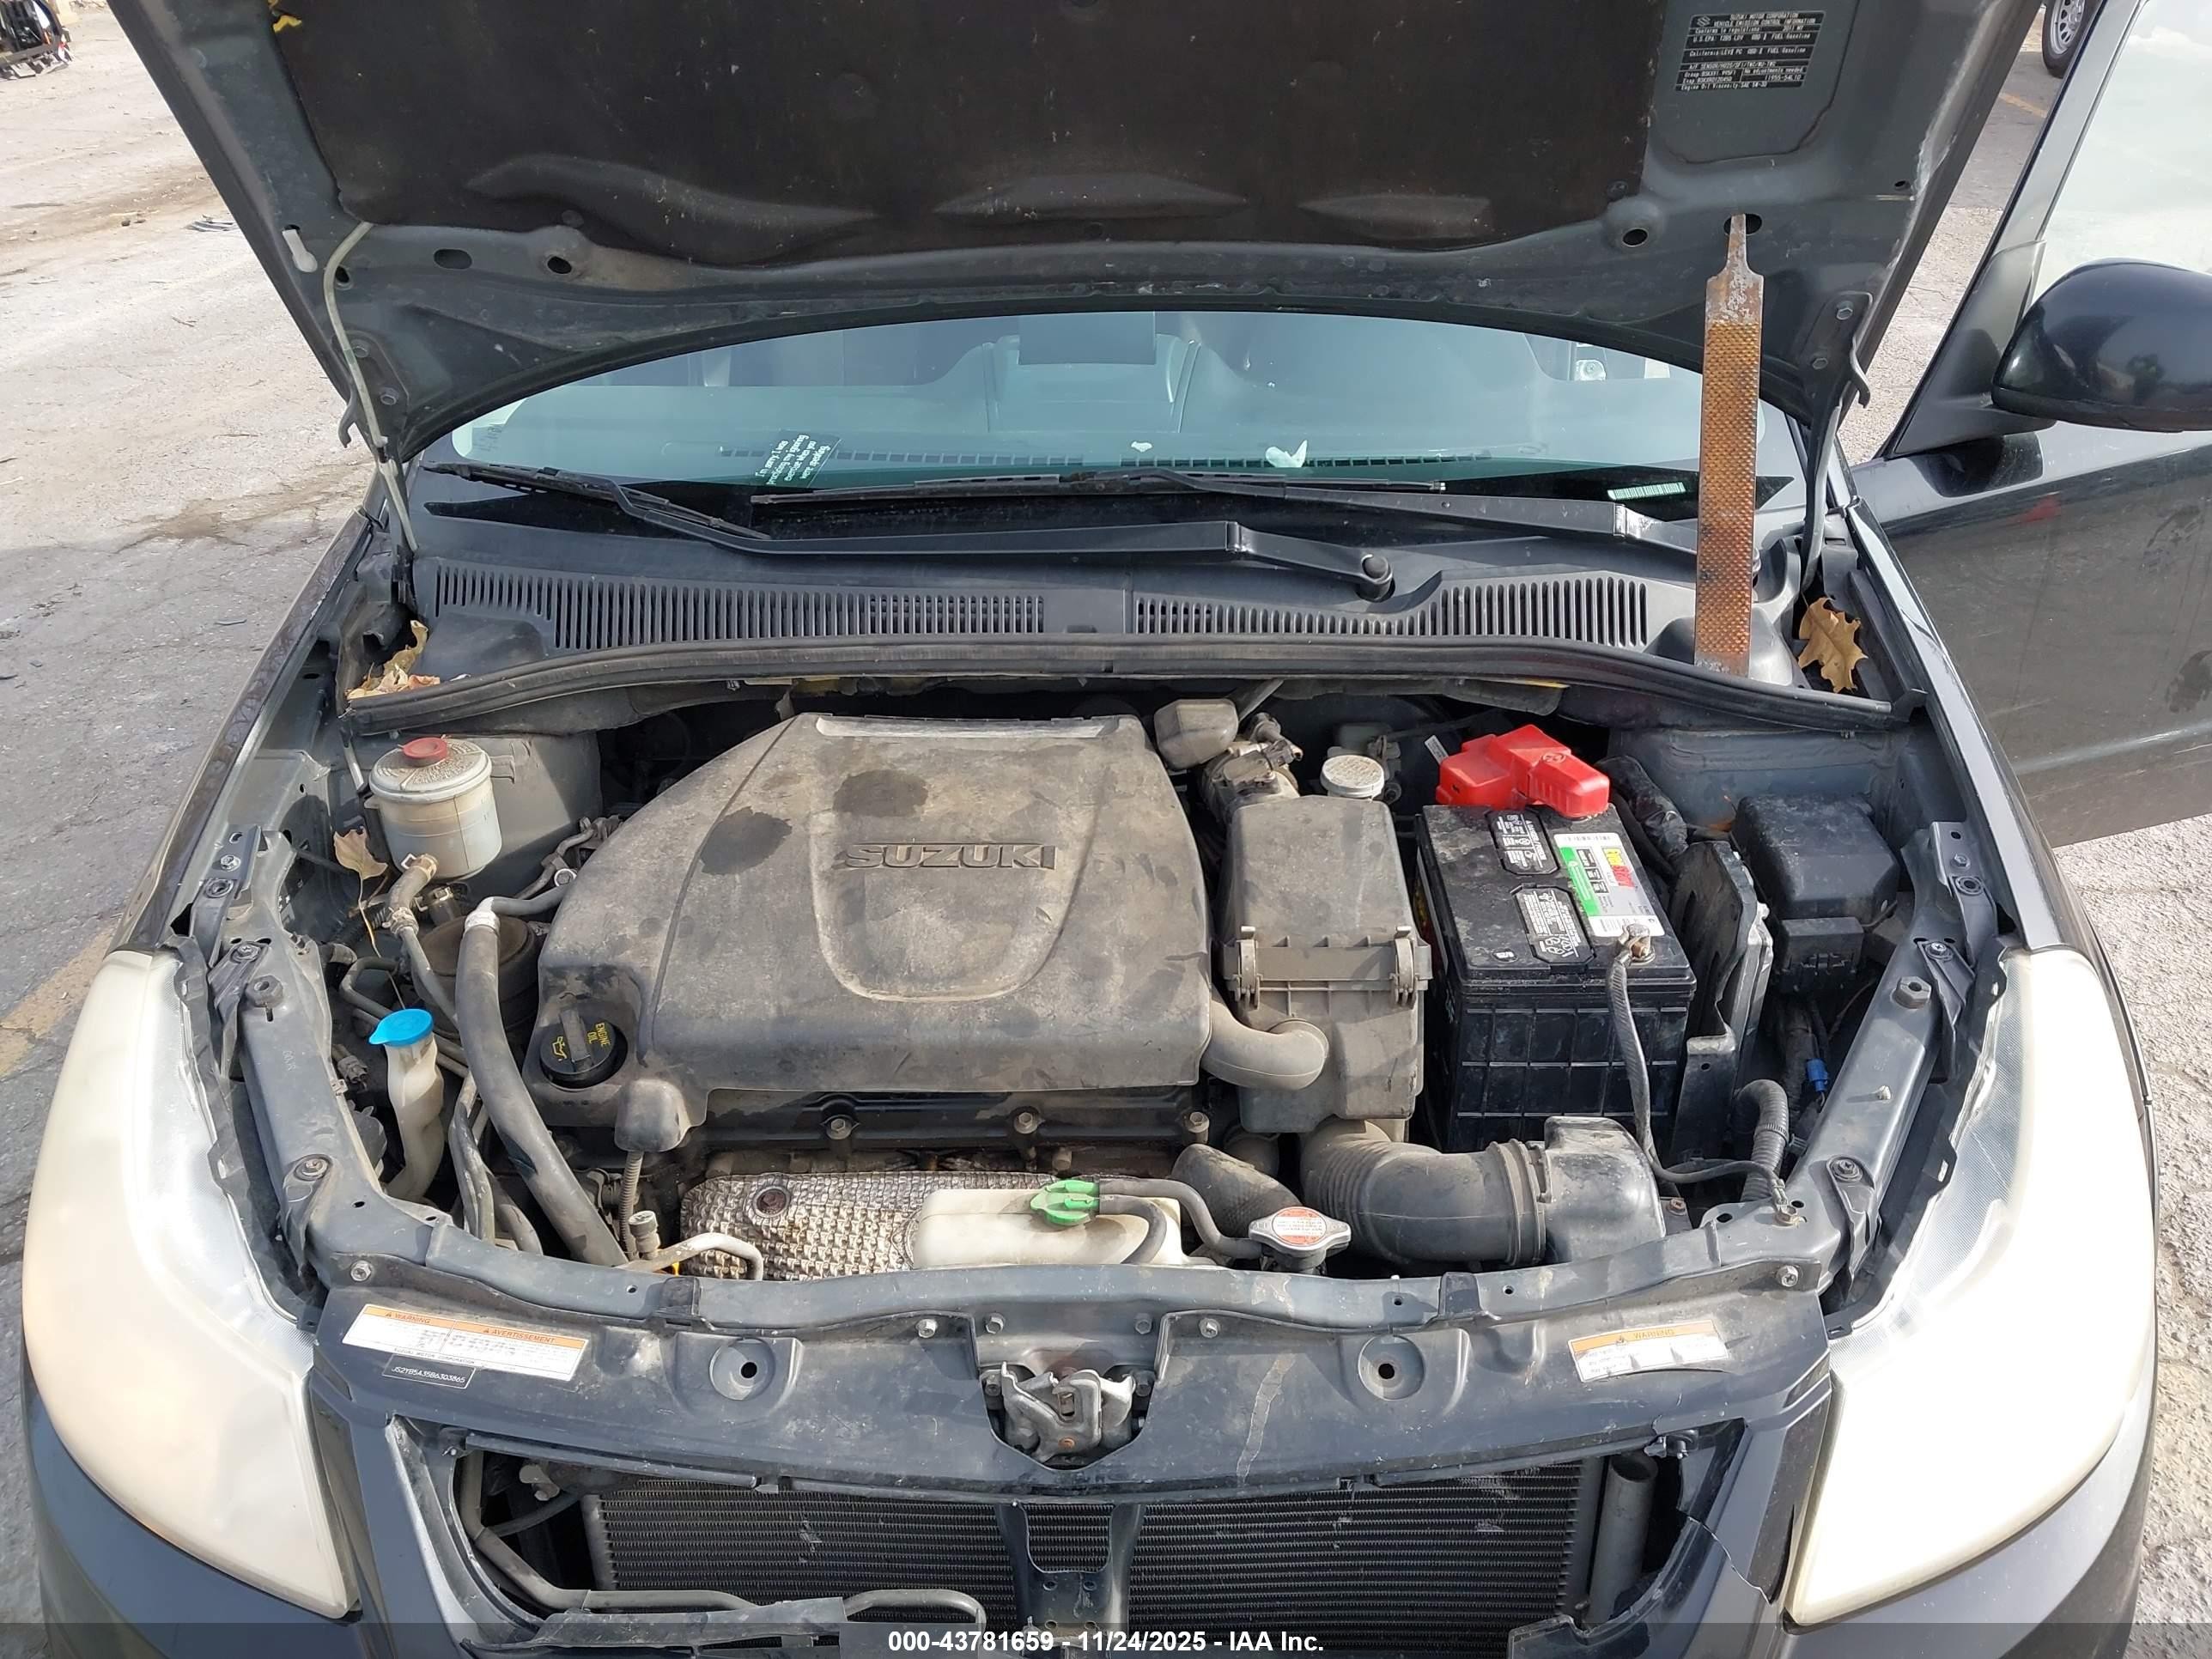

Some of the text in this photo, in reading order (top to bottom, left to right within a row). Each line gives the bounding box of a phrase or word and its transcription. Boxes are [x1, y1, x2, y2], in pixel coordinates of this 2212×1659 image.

[841, 843, 1056, 870] SUZUKI
[587, 1031, 599, 1044] OIL
[595, 1022, 611, 1048] ENGINE
[394, 1312, 431, 1323] WARNING
[492, 1328, 556, 1343] AVERTISSEMENT
[1632, 1328, 1676, 1340] WARNING
